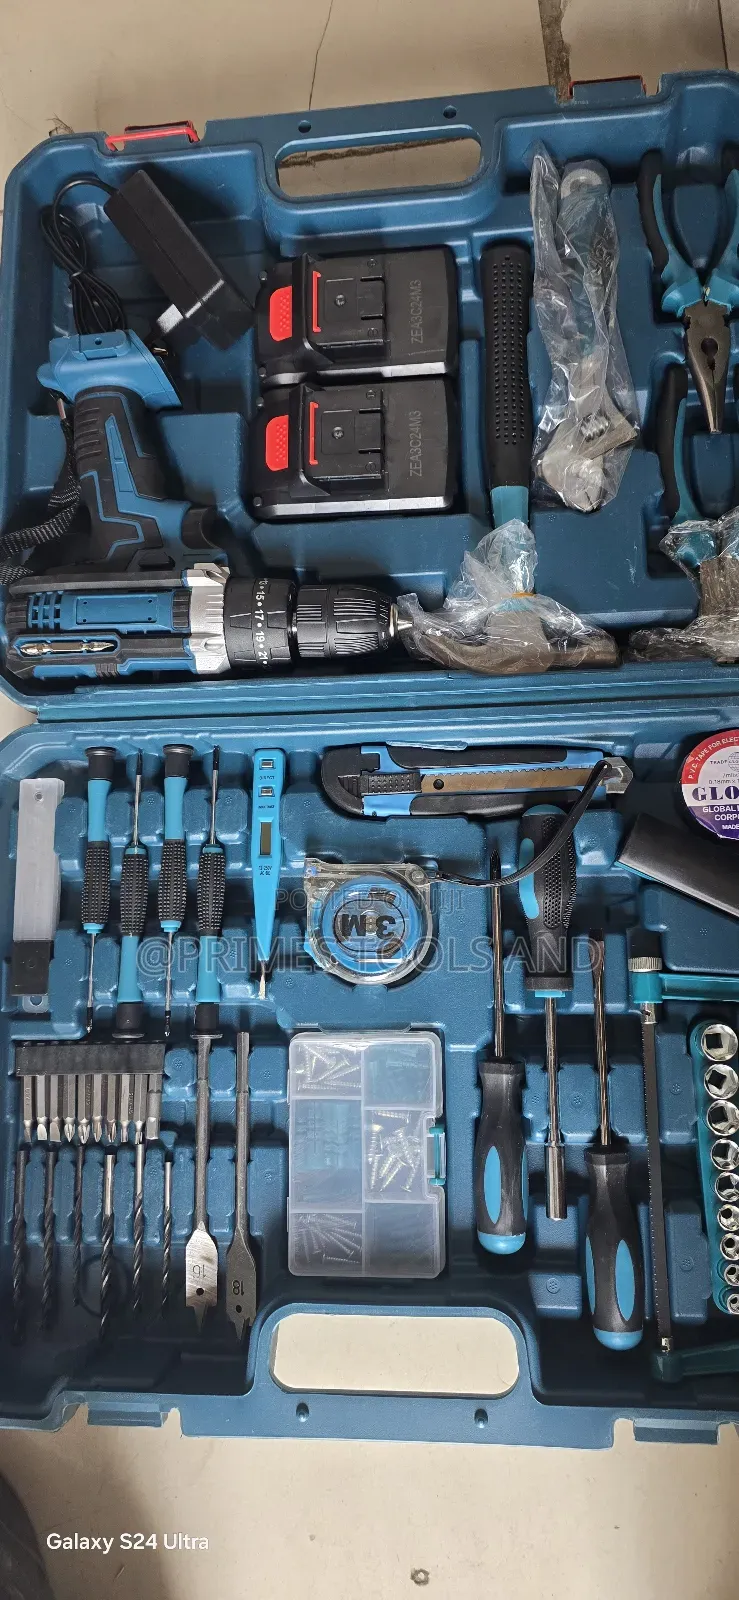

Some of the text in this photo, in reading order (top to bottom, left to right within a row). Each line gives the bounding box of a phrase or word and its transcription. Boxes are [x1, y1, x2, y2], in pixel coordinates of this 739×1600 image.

[410, 279, 424, 344] ZEA3C24M3
[409, 410, 422, 477] ZEA3C24M3
[256, 591, 266, 600] 15
[254, 609, 265, 620] 17
[256, 631, 265, 641] 19
[258, 651, 268, 660] 21
[695, 747, 710, 761] TAPE
[707, 740, 722, 751] FOR
[702, 805, 737, 813] GLOBAL
[341, 913, 397, 939] 3M
[193, 1264, 207, 1278] 16
[232, 1279, 245, 1296] 18
